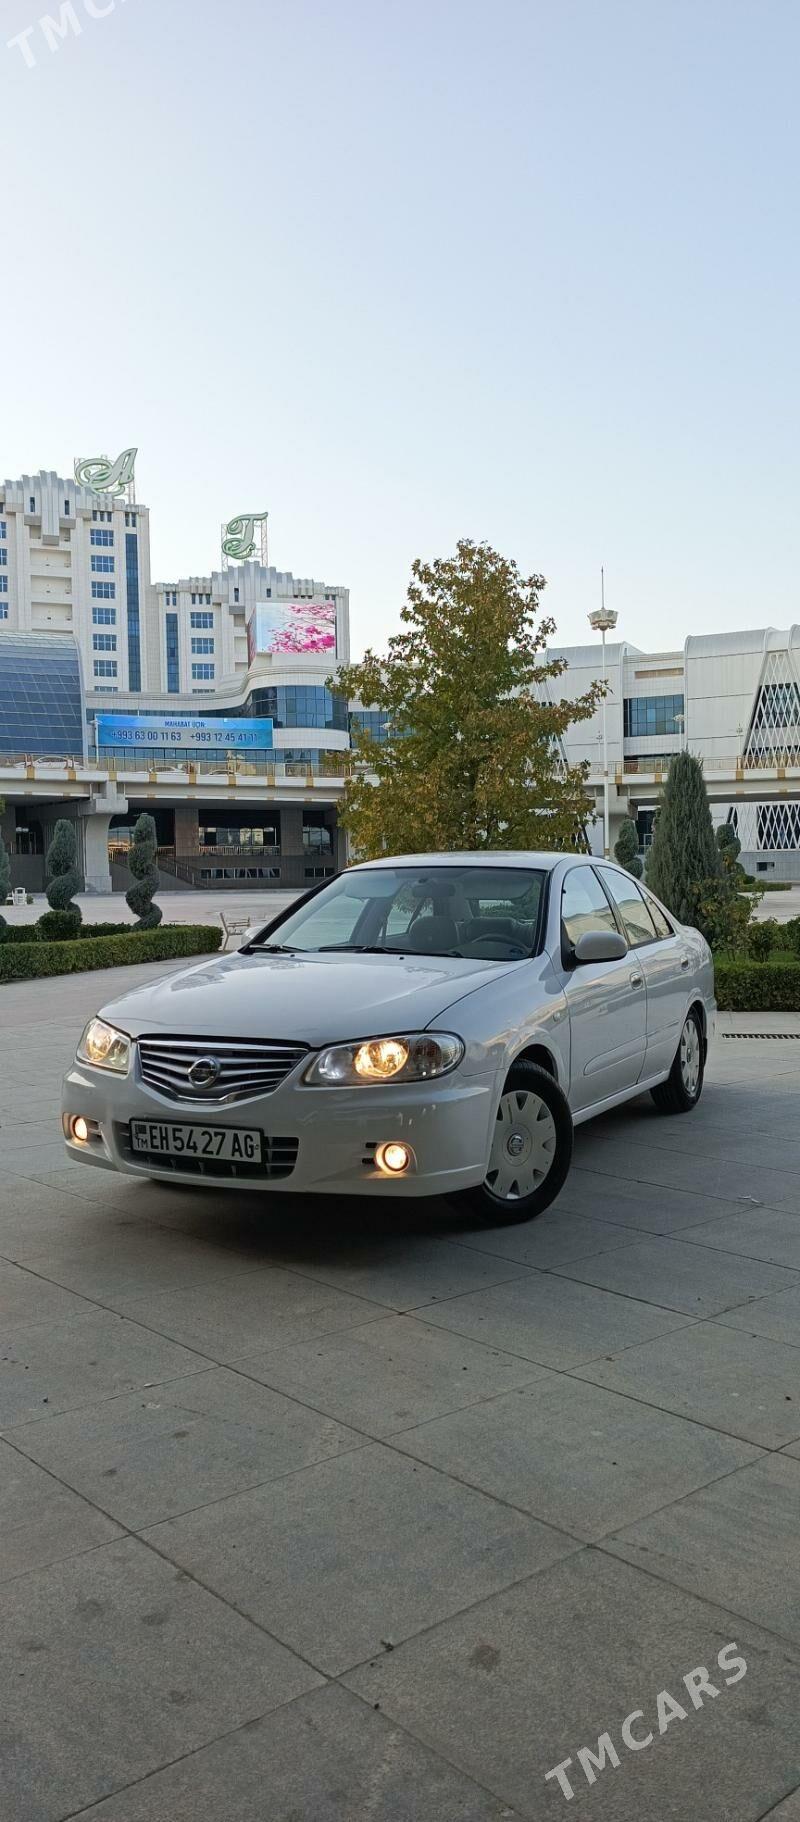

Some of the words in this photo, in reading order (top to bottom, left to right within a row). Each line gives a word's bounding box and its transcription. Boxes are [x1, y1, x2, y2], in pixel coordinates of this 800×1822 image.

[112, 731, 133, 740] +993
[135, 731, 145, 740] 63
[147, 731, 158, 741] 00
[160, 732, 169, 741] 11
[170, 732, 182, 741] 63
[190, 732, 211, 741] +993
[214, 732, 223, 741] 12
[225, 733, 235, 741] 45
[238, 733, 247, 741] 41
[137, 1137, 149, 1149] TM
[231, 1133, 254, 1158] AG
